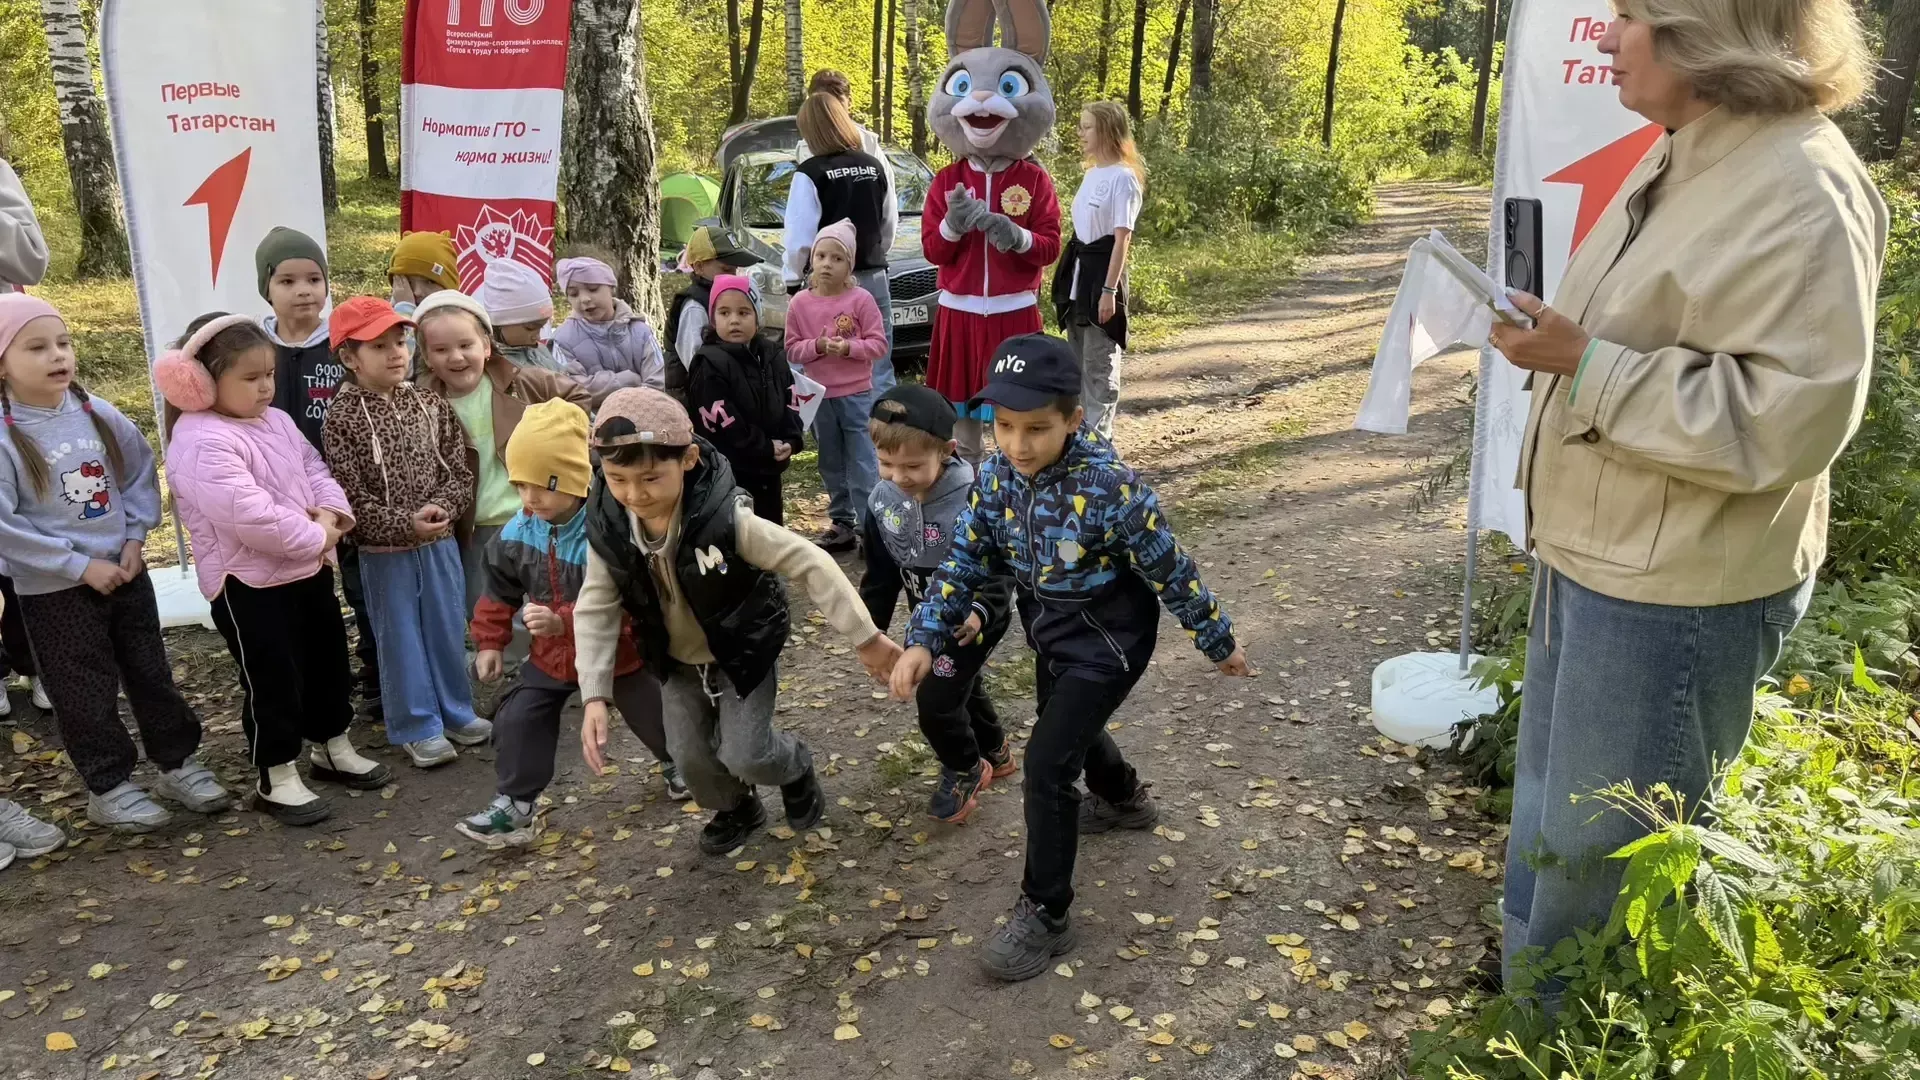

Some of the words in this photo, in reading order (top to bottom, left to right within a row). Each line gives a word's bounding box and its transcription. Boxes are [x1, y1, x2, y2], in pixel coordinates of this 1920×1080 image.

[446, 29, 493, 38] Всероссийский
[1569, 17, 1607, 42] Пе
[446, 38, 531, 47] физкультурно-спортивный
[472, 47, 492, 55] труду
[1562, 59, 1612, 84] Тат
[161, 82, 240, 104] Первые
[166, 114, 276, 133] Татарстан
[422, 116, 491, 137] Норматив
[493, 121, 526, 137] ГТО
[455, 150, 498, 166] норма
[500, 149, 552, 164] жизни!
[826, 166, 877, 180] ПЕРВЫЕ
[904, 306, 924, 319] 716
[315, 363, 347, 378] GOOD
[995, 354, 1026, 373] NYC
[698, 399, 736, 433] M
